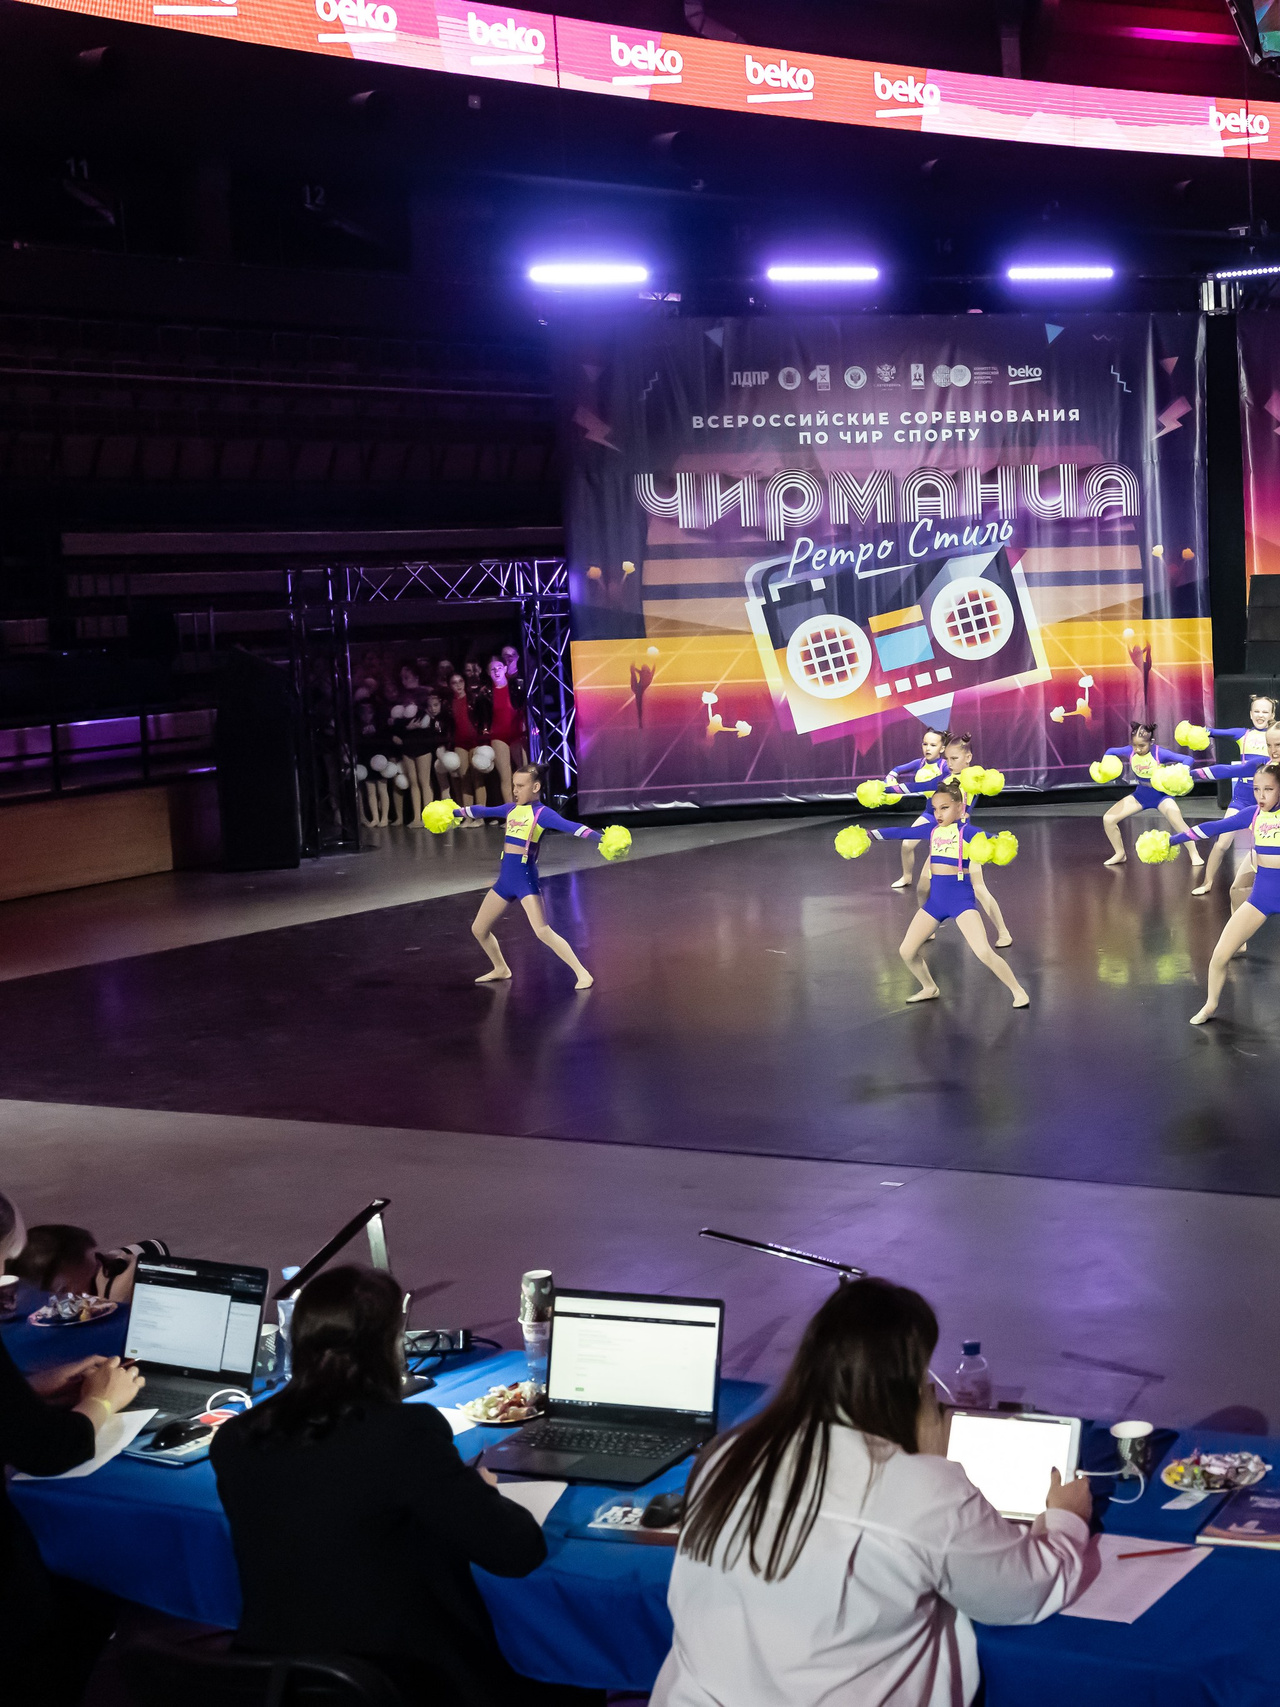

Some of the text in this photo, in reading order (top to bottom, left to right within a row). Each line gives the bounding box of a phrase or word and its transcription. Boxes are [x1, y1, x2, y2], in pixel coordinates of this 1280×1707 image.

[468, 12, 546, 54] beko
[610, 34, 684, 74] beko
[745, 55, 815, 92] beko
[873, 72, 940, 105] beko
[1208, 106, 1270, 136] beko
[730, 371, 770, 387] ЛДПР
[1007, 364, 1043, 378] beko
[692, 408, 1081, 430] ВСЕРОССИЙСКИЕ СОРЕВНОВАНИЯ
[799, 427, 981, 445] ПО ЧИР СПОРТУ
[787, 518, 1014, 580] Ретро Стиль
